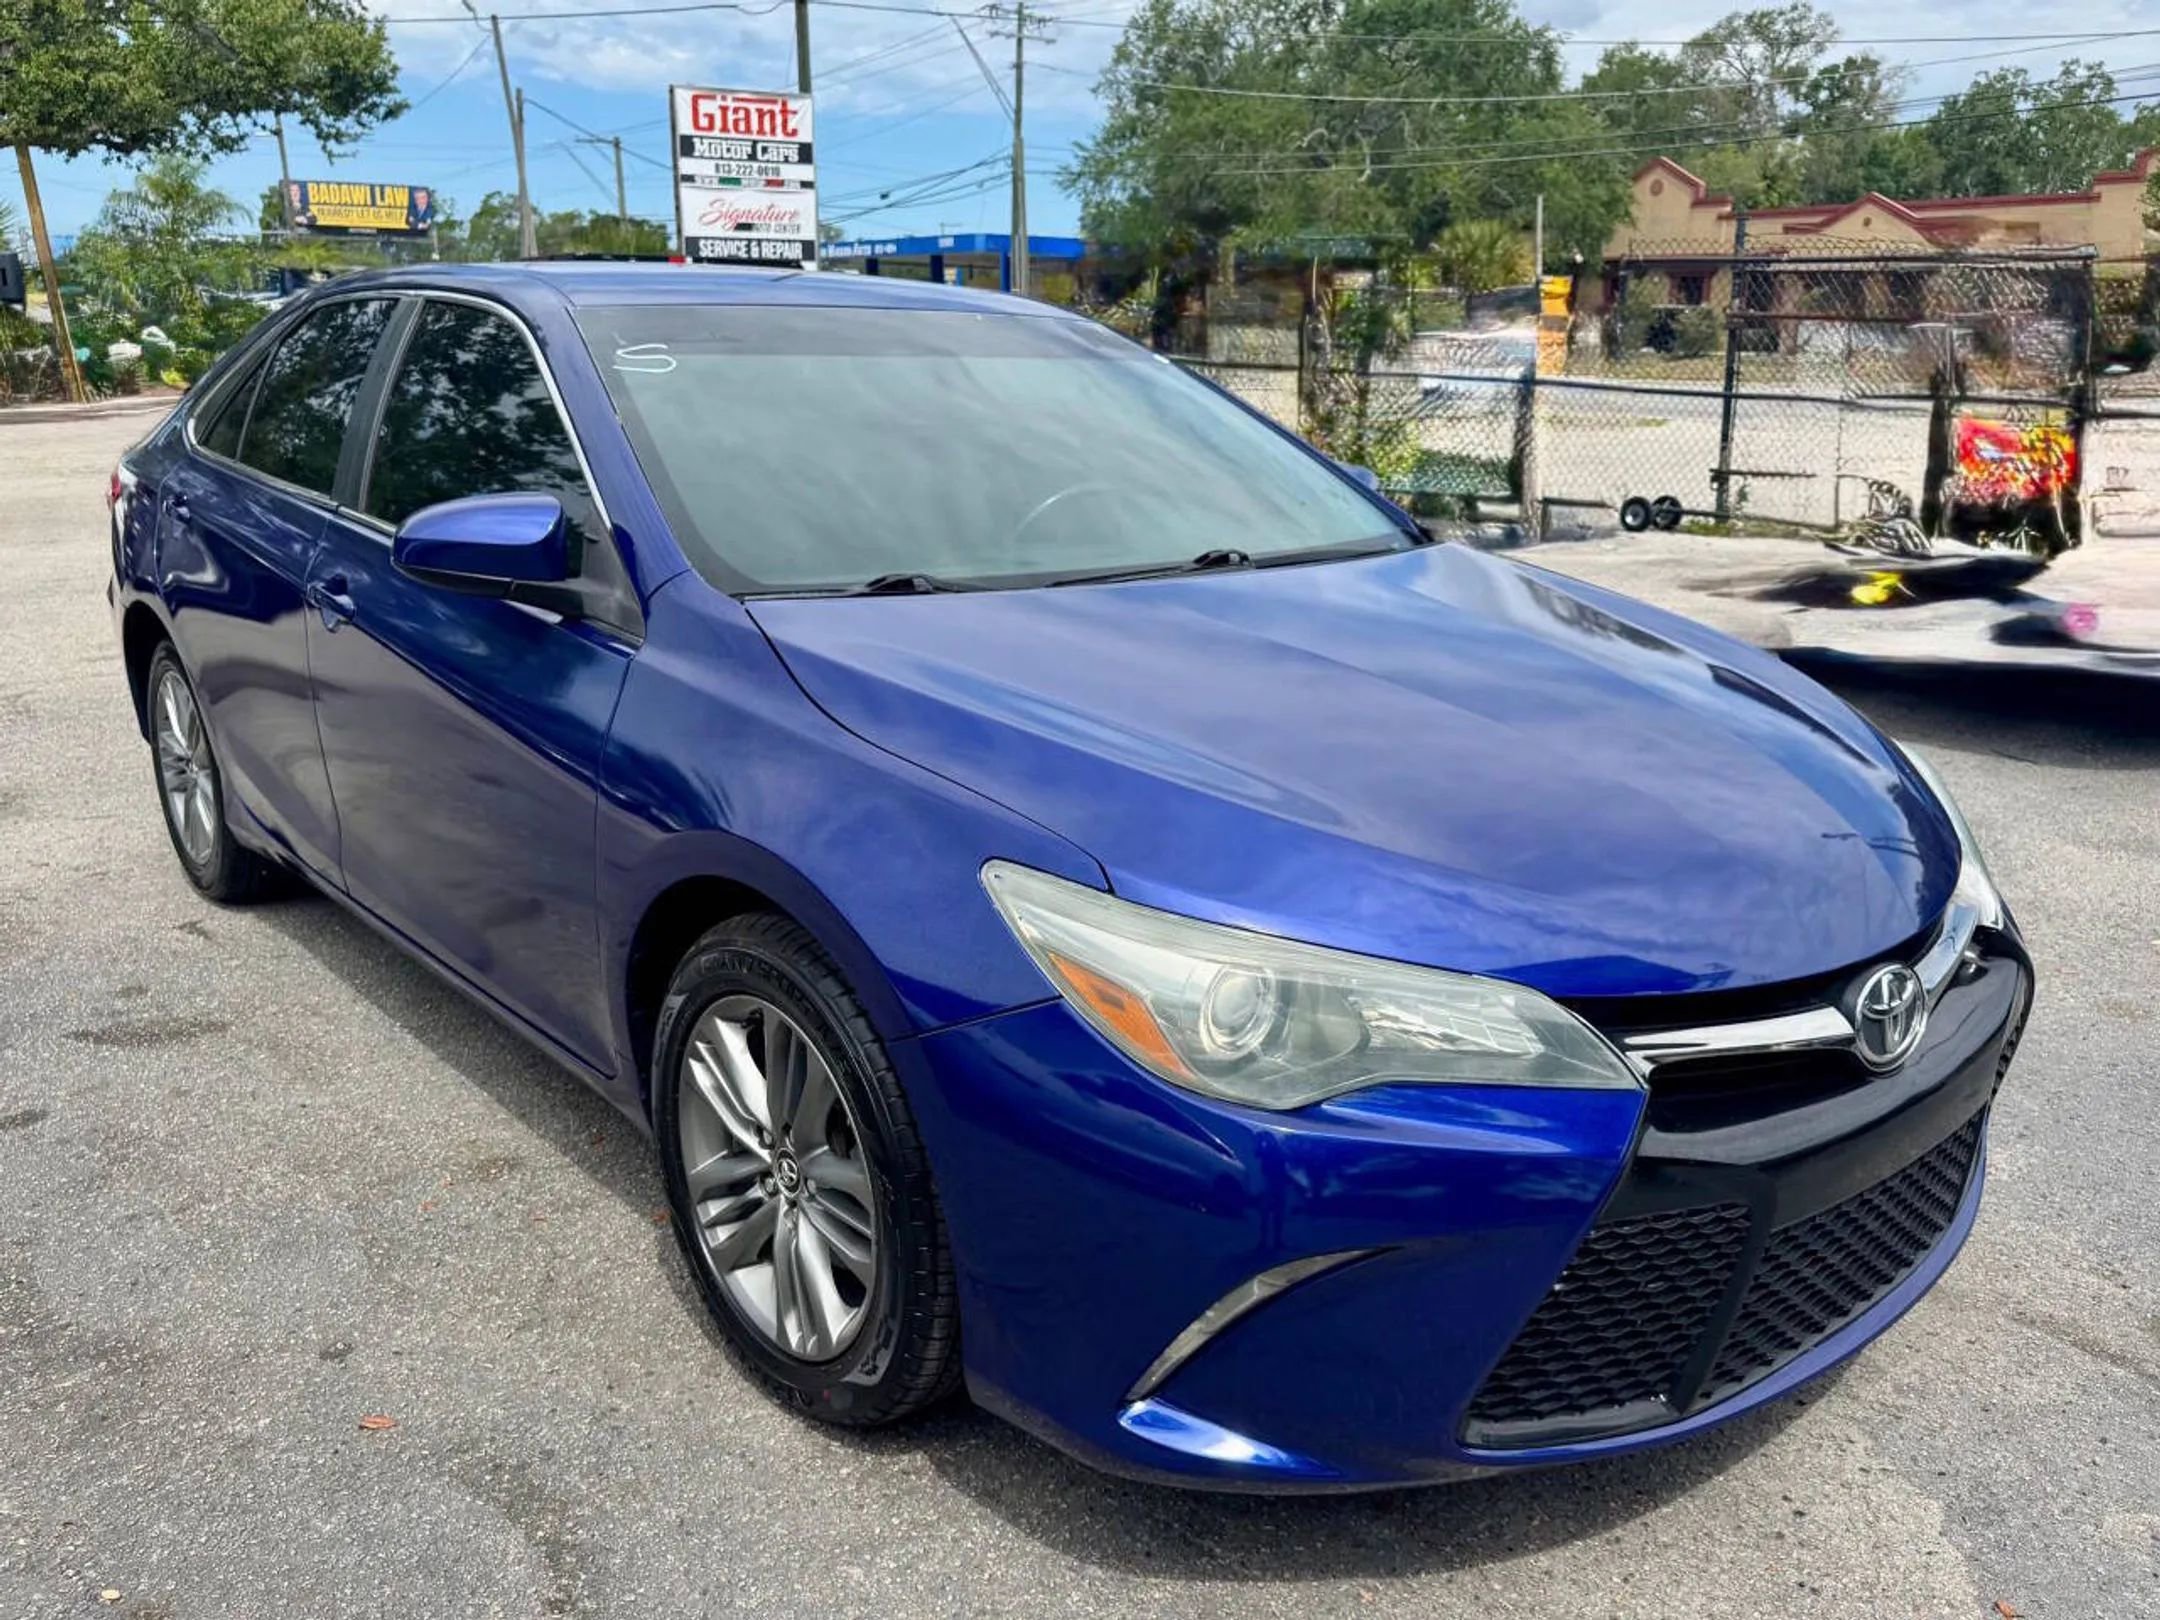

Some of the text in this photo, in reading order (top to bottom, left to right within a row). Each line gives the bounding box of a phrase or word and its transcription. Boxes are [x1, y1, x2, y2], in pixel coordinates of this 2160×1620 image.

[692, 93, 799, 138] Giant
[692, 137, 800, 162] Motor Cars
[308, 183, 409, 207] BADAWI LAW
[699, 199, 800, 232] Signature
[698, 239, 748, 258] SERVICE
[750, 241, 760, 258] &
[761, 241, 803, 259] REPAIR
